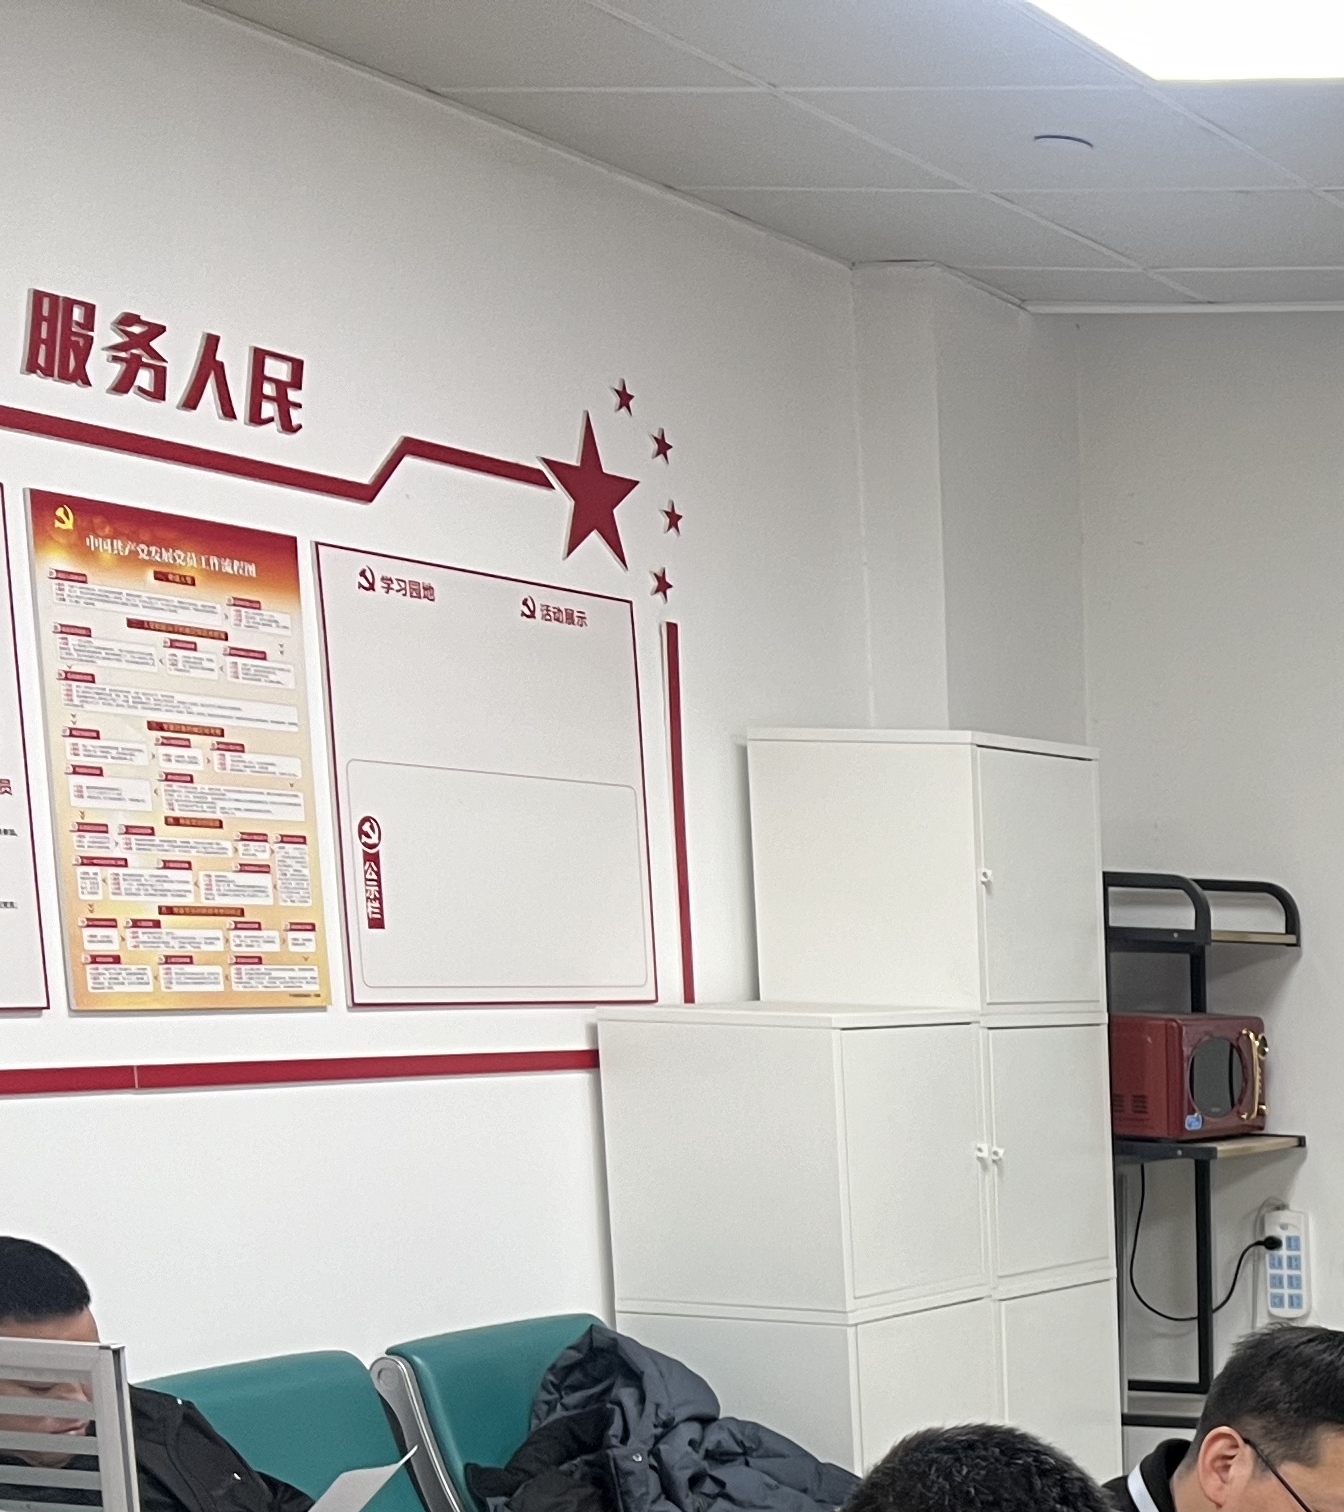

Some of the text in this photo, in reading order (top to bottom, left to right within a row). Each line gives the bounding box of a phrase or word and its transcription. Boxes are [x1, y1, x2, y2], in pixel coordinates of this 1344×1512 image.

[24, 289, 304, 433] 服务人民
[379, 575, 436, 602] 学习园地
[540, 603, 588, 628] 活动展示
[364, 861, 382, 918] 公示栏
